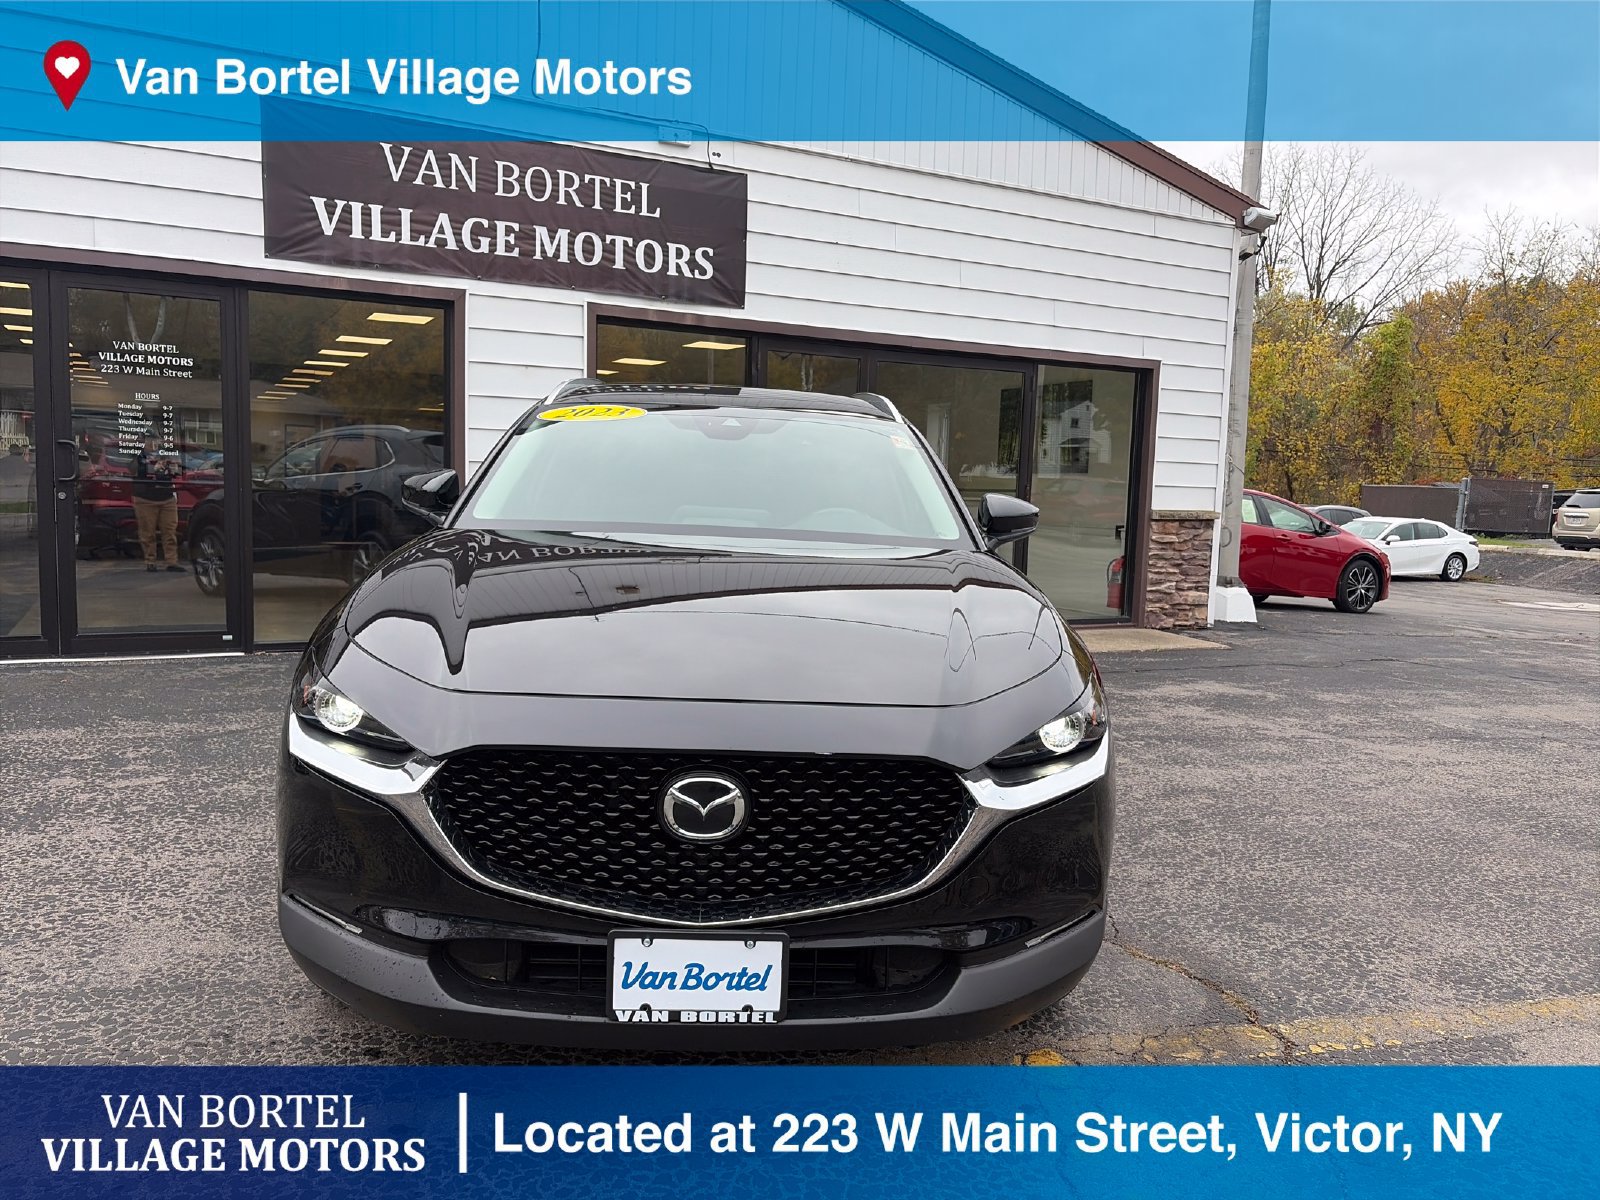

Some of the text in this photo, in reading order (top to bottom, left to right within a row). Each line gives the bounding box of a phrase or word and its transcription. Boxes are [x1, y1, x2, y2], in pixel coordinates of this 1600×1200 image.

[379, 142, 661, 218] VAN BORTEL
[309, 196, 715, 280] VILLAGE MOTORS
[113, 340, 180, 354] VAN BORTEL
[98, 352, 194, 367] VILLAGE MOTORS
[100, 364, 193, 378] 223 W Main Street
[135, 392, 160, 401] HOURS
[118, 403, 142, 411] Monday
[118, 410, 144, 419] Tuesday
[118, 418, 153, 426] Wednesday
[118, 426, 148, 434] Thursday
[118, 433, 139, 441] Friday
[118, 441, 146, 449] Saturday
[118, 448, 142, 456] Sunday
[621, 961, 773, 991] Van Bortel
[615, 1010, 777, 1023] VAN BORTEL
